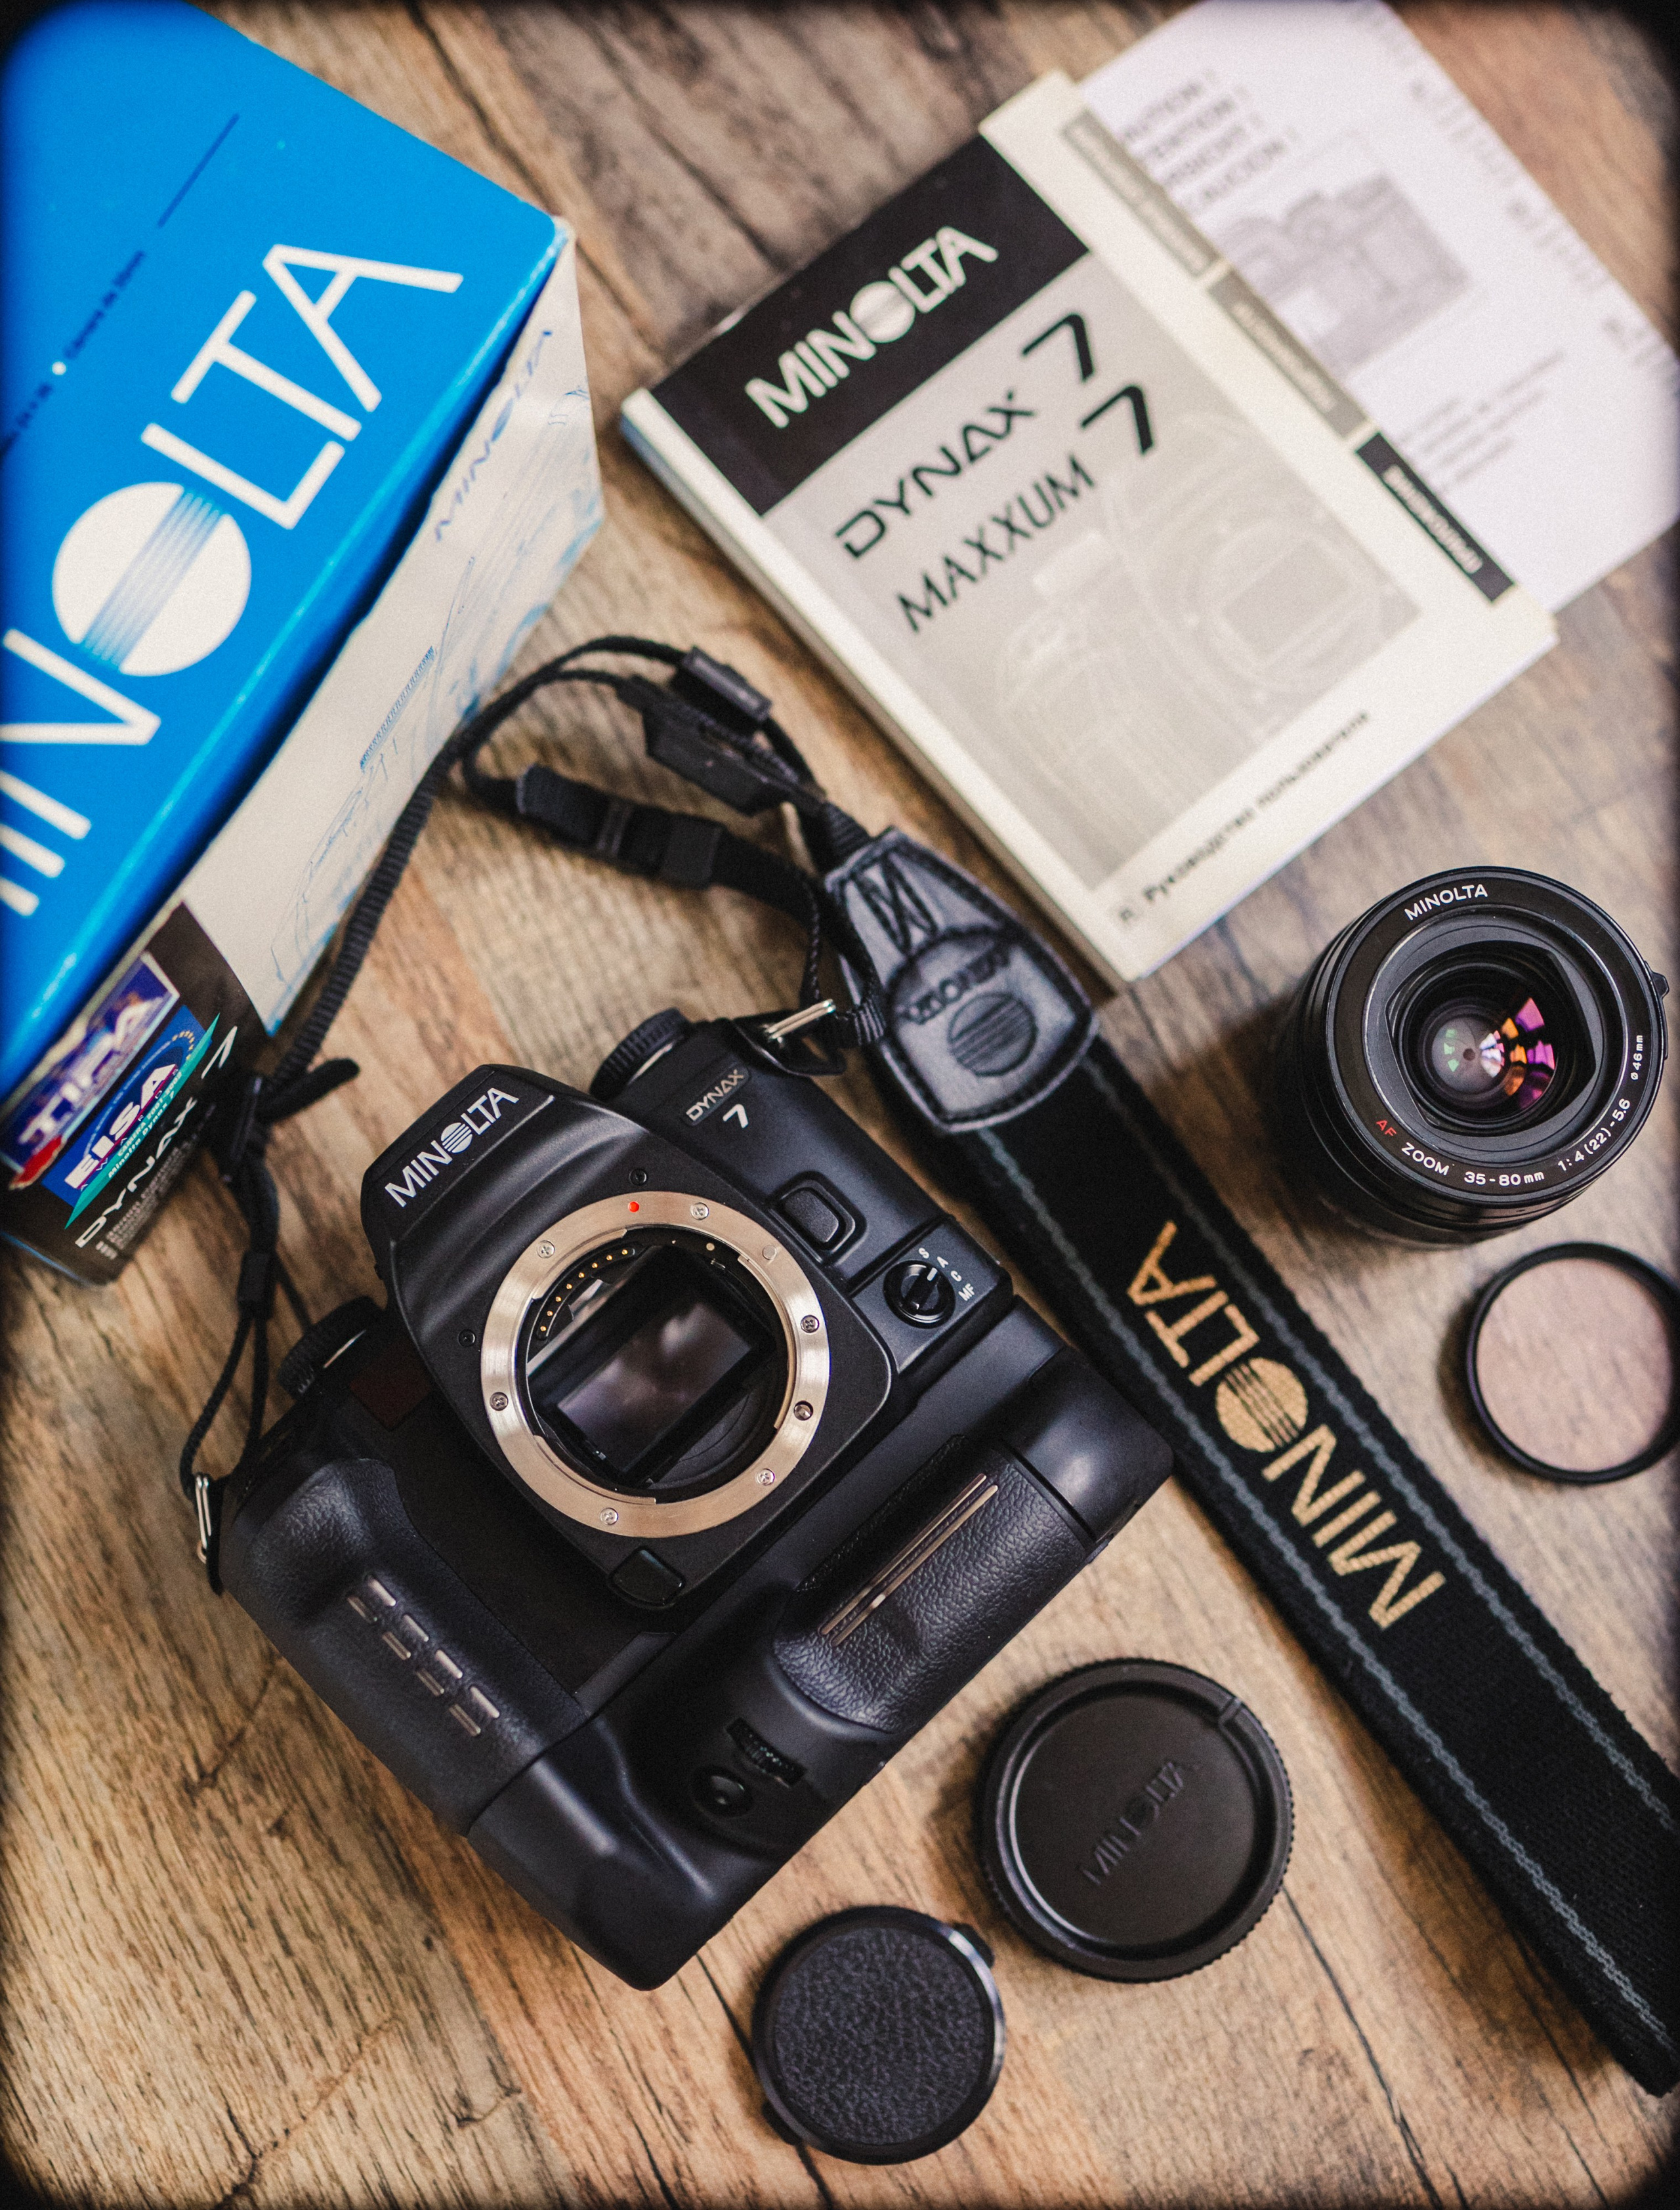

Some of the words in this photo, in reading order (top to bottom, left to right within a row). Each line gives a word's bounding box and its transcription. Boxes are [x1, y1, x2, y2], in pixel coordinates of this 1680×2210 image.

[745, 226, 998, 428] MINOLTA
[835, 390, 1036, 559] DYNAX
[1020, 313, 1094, 382] 7
[897, 451, 1095, 633] MAXXUM
[1081, 385, 1154, 455] 7
[0, 243, 463, 917] NOLTA
[1404, 883, 1488, 921] MINOLTA
[65, 1064, 177, 1190] EISA
[80, 1068, 179, 1192] AWARDS
[686, 1068, 745, 1123] DYNAX
[723, 1104, 749, 1129] 7
[75, 1096, 197, 1248] DYNAX
[200, 1026, 238, 1080] 7
[108, 1138, 142, 1178] Minolta
[141, 1104, 168, 1138] Dynax
[117, 1121, 147, 1157] CAMERA
[385, 1087, 519, 1208] MINOLTA
[1376, 1118, 1397, 1138] AF
[1400, 1142, 1450, 1176] ZOOM
[919, 1247, 930, 1259] S
[938, 1256, 949, 1268] A
[952, 1271, 962, 1282] C
[958, 1283, 975, 1301] MF
[1127, 1220, 1446, 1631] MINOLTA
